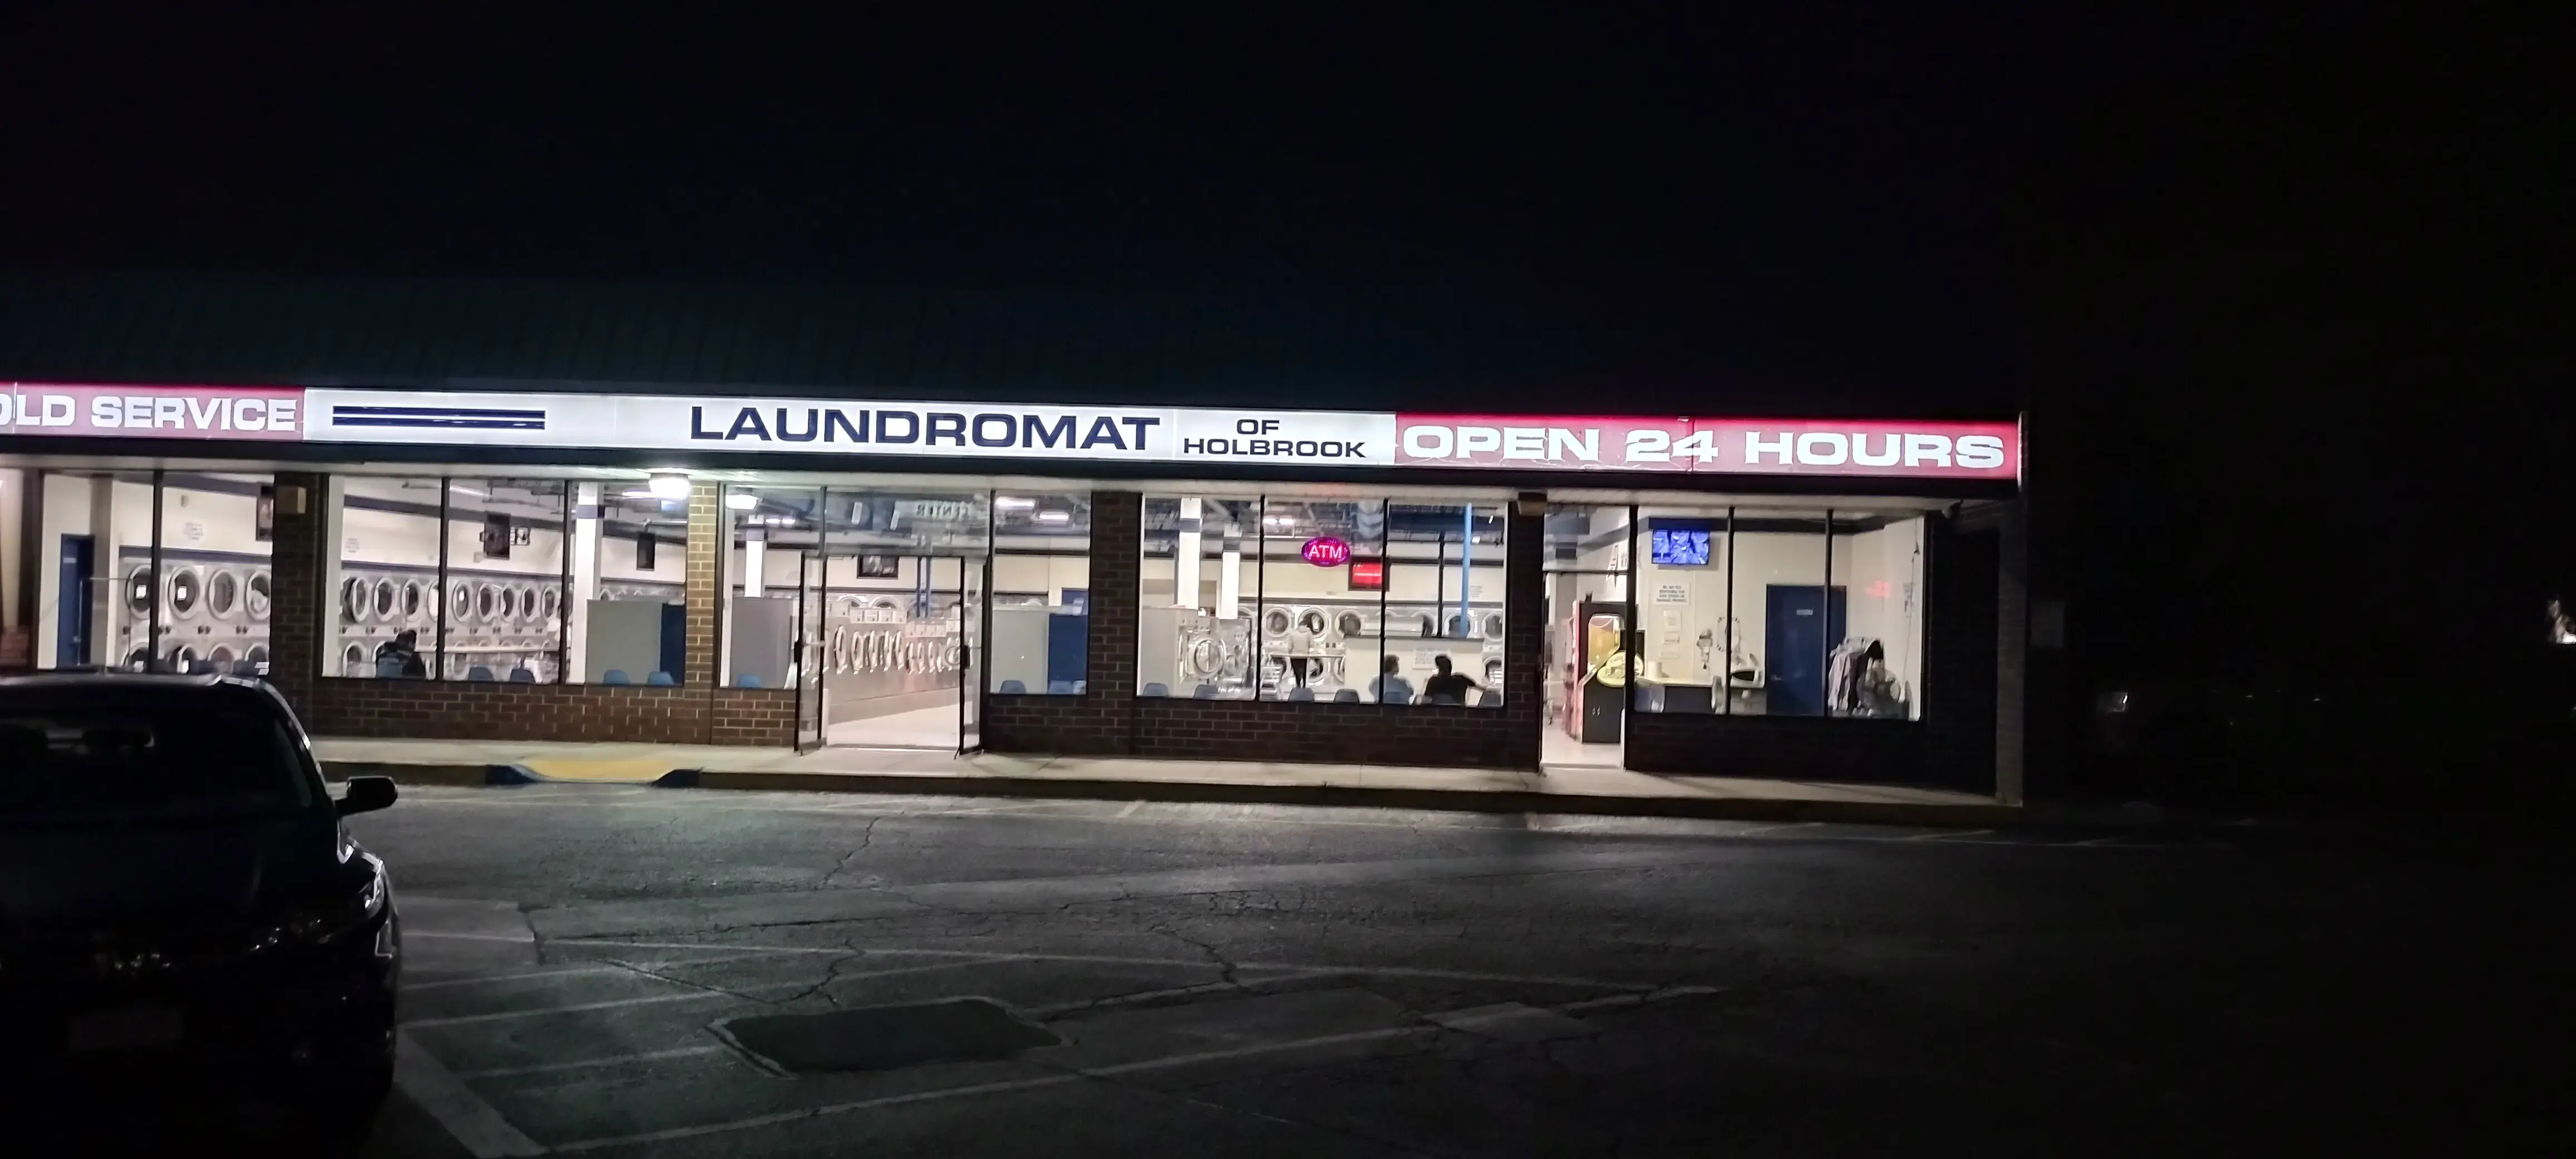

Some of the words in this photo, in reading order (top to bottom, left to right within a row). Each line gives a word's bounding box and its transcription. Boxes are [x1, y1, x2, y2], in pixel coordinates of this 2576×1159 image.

[91, 396, 297, 432] SERVICE
[1236, 418, 1280, 435] OF
[690, 406, 1160, 451] LAUNDROMAT
[1183, 438, 1367, 458] HOLBROOK
[1403, 425, 1600, 462] OPEN
[1624, 429, 1719, 463] 24
[1744, 431, 2004, 469] HOURS
[1308, 544, 1343, 559] ATM
